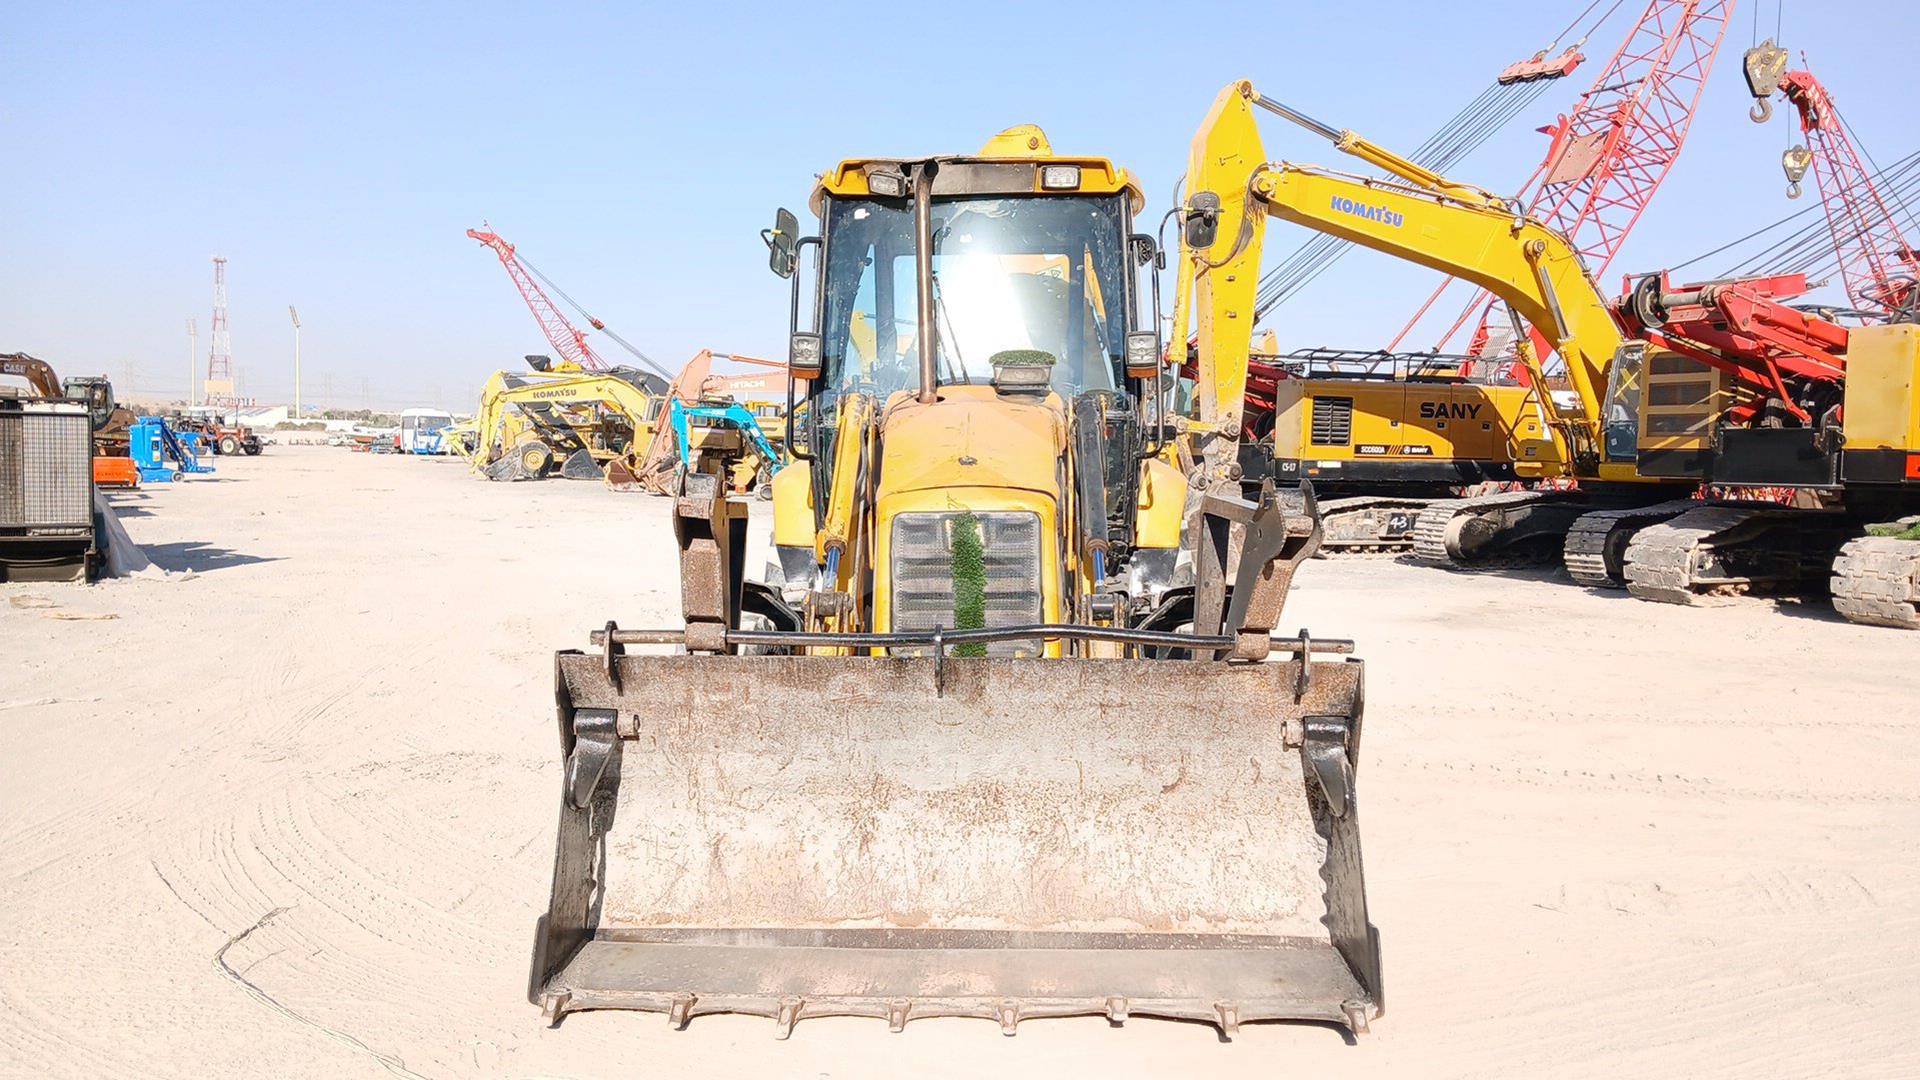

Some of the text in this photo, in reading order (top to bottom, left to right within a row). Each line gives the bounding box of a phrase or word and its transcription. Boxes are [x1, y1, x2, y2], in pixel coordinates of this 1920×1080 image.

[3, 363, 26, 373] CASE
[729, 380, 766, 390] HITACHI
[1420, 402, 1482, 419] SANY
[1390, 516, 1408, 530] 43
